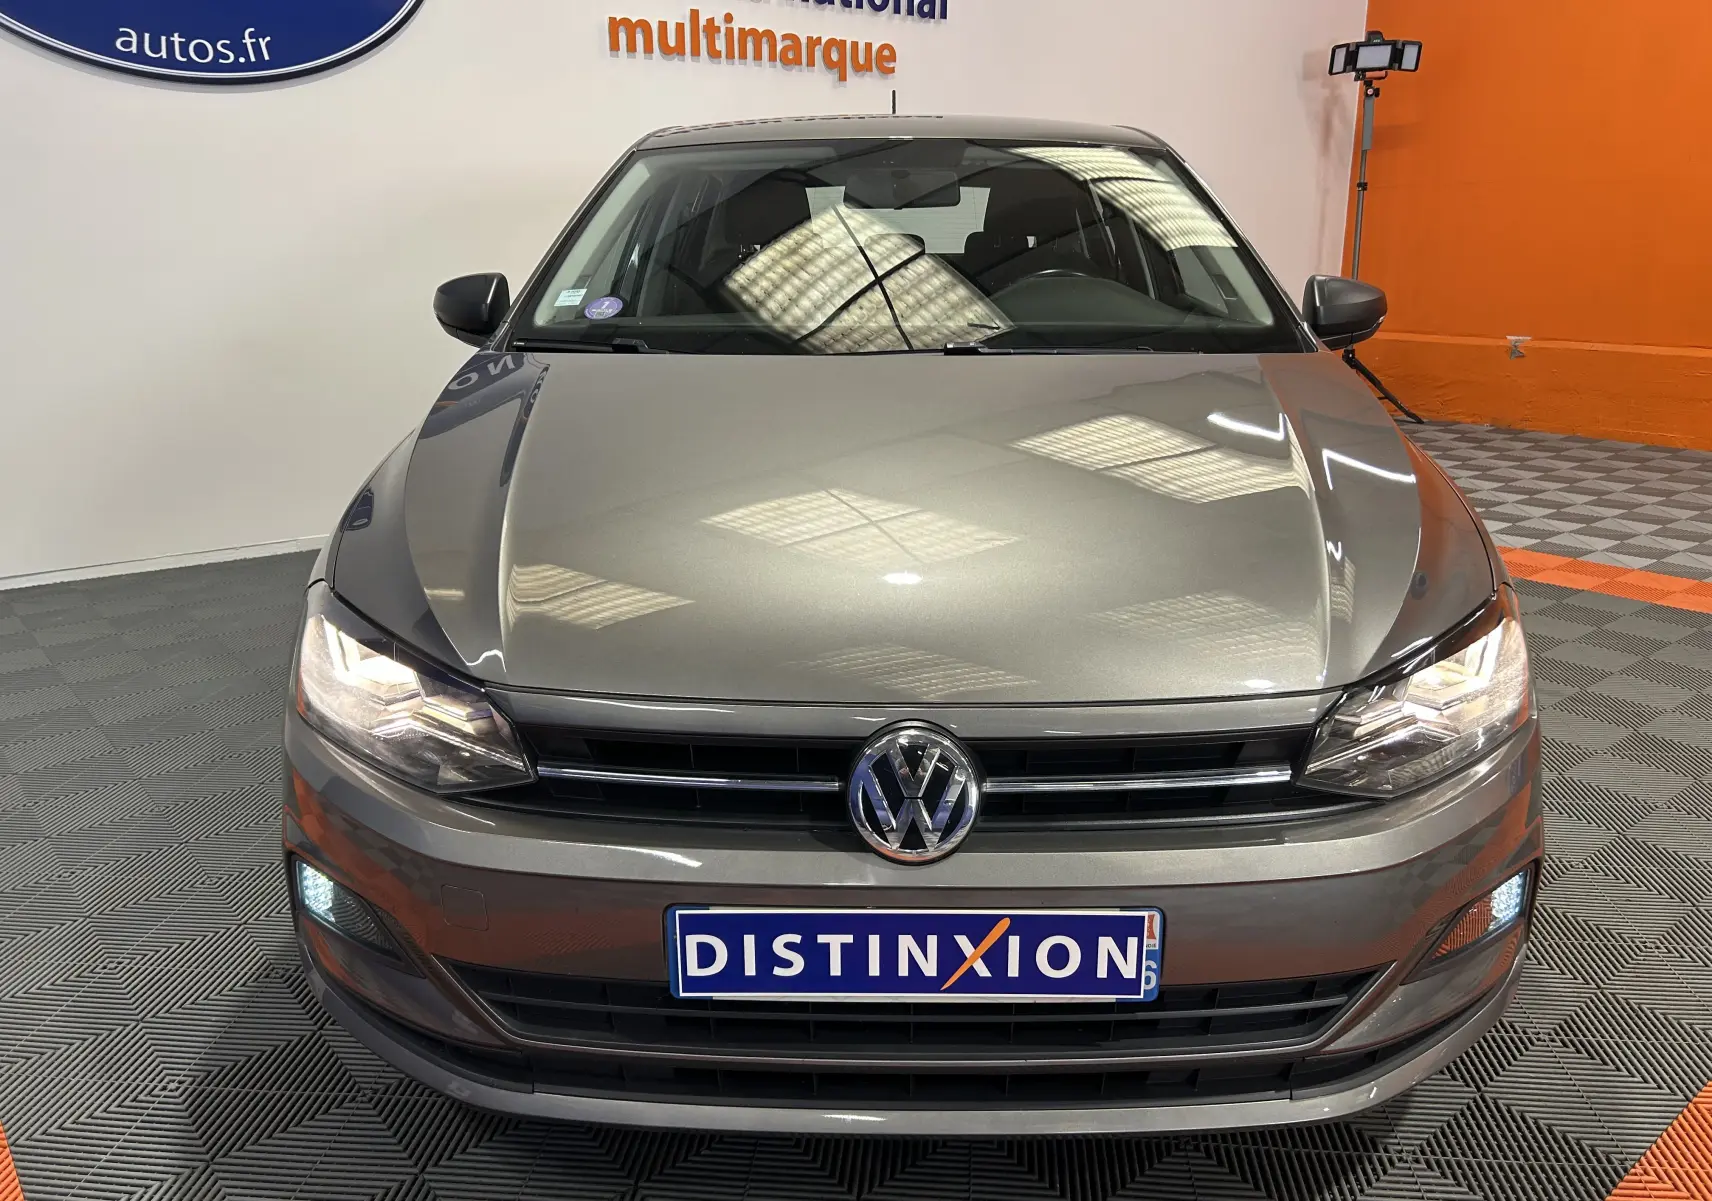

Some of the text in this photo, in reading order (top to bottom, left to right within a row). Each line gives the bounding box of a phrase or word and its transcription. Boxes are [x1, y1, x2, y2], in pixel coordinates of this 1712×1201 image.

[115, 27, 272, 64] autos.fr
[608, 9, 897, 82] multimarque
[684, 916, 1139, 991] DISTINXION
